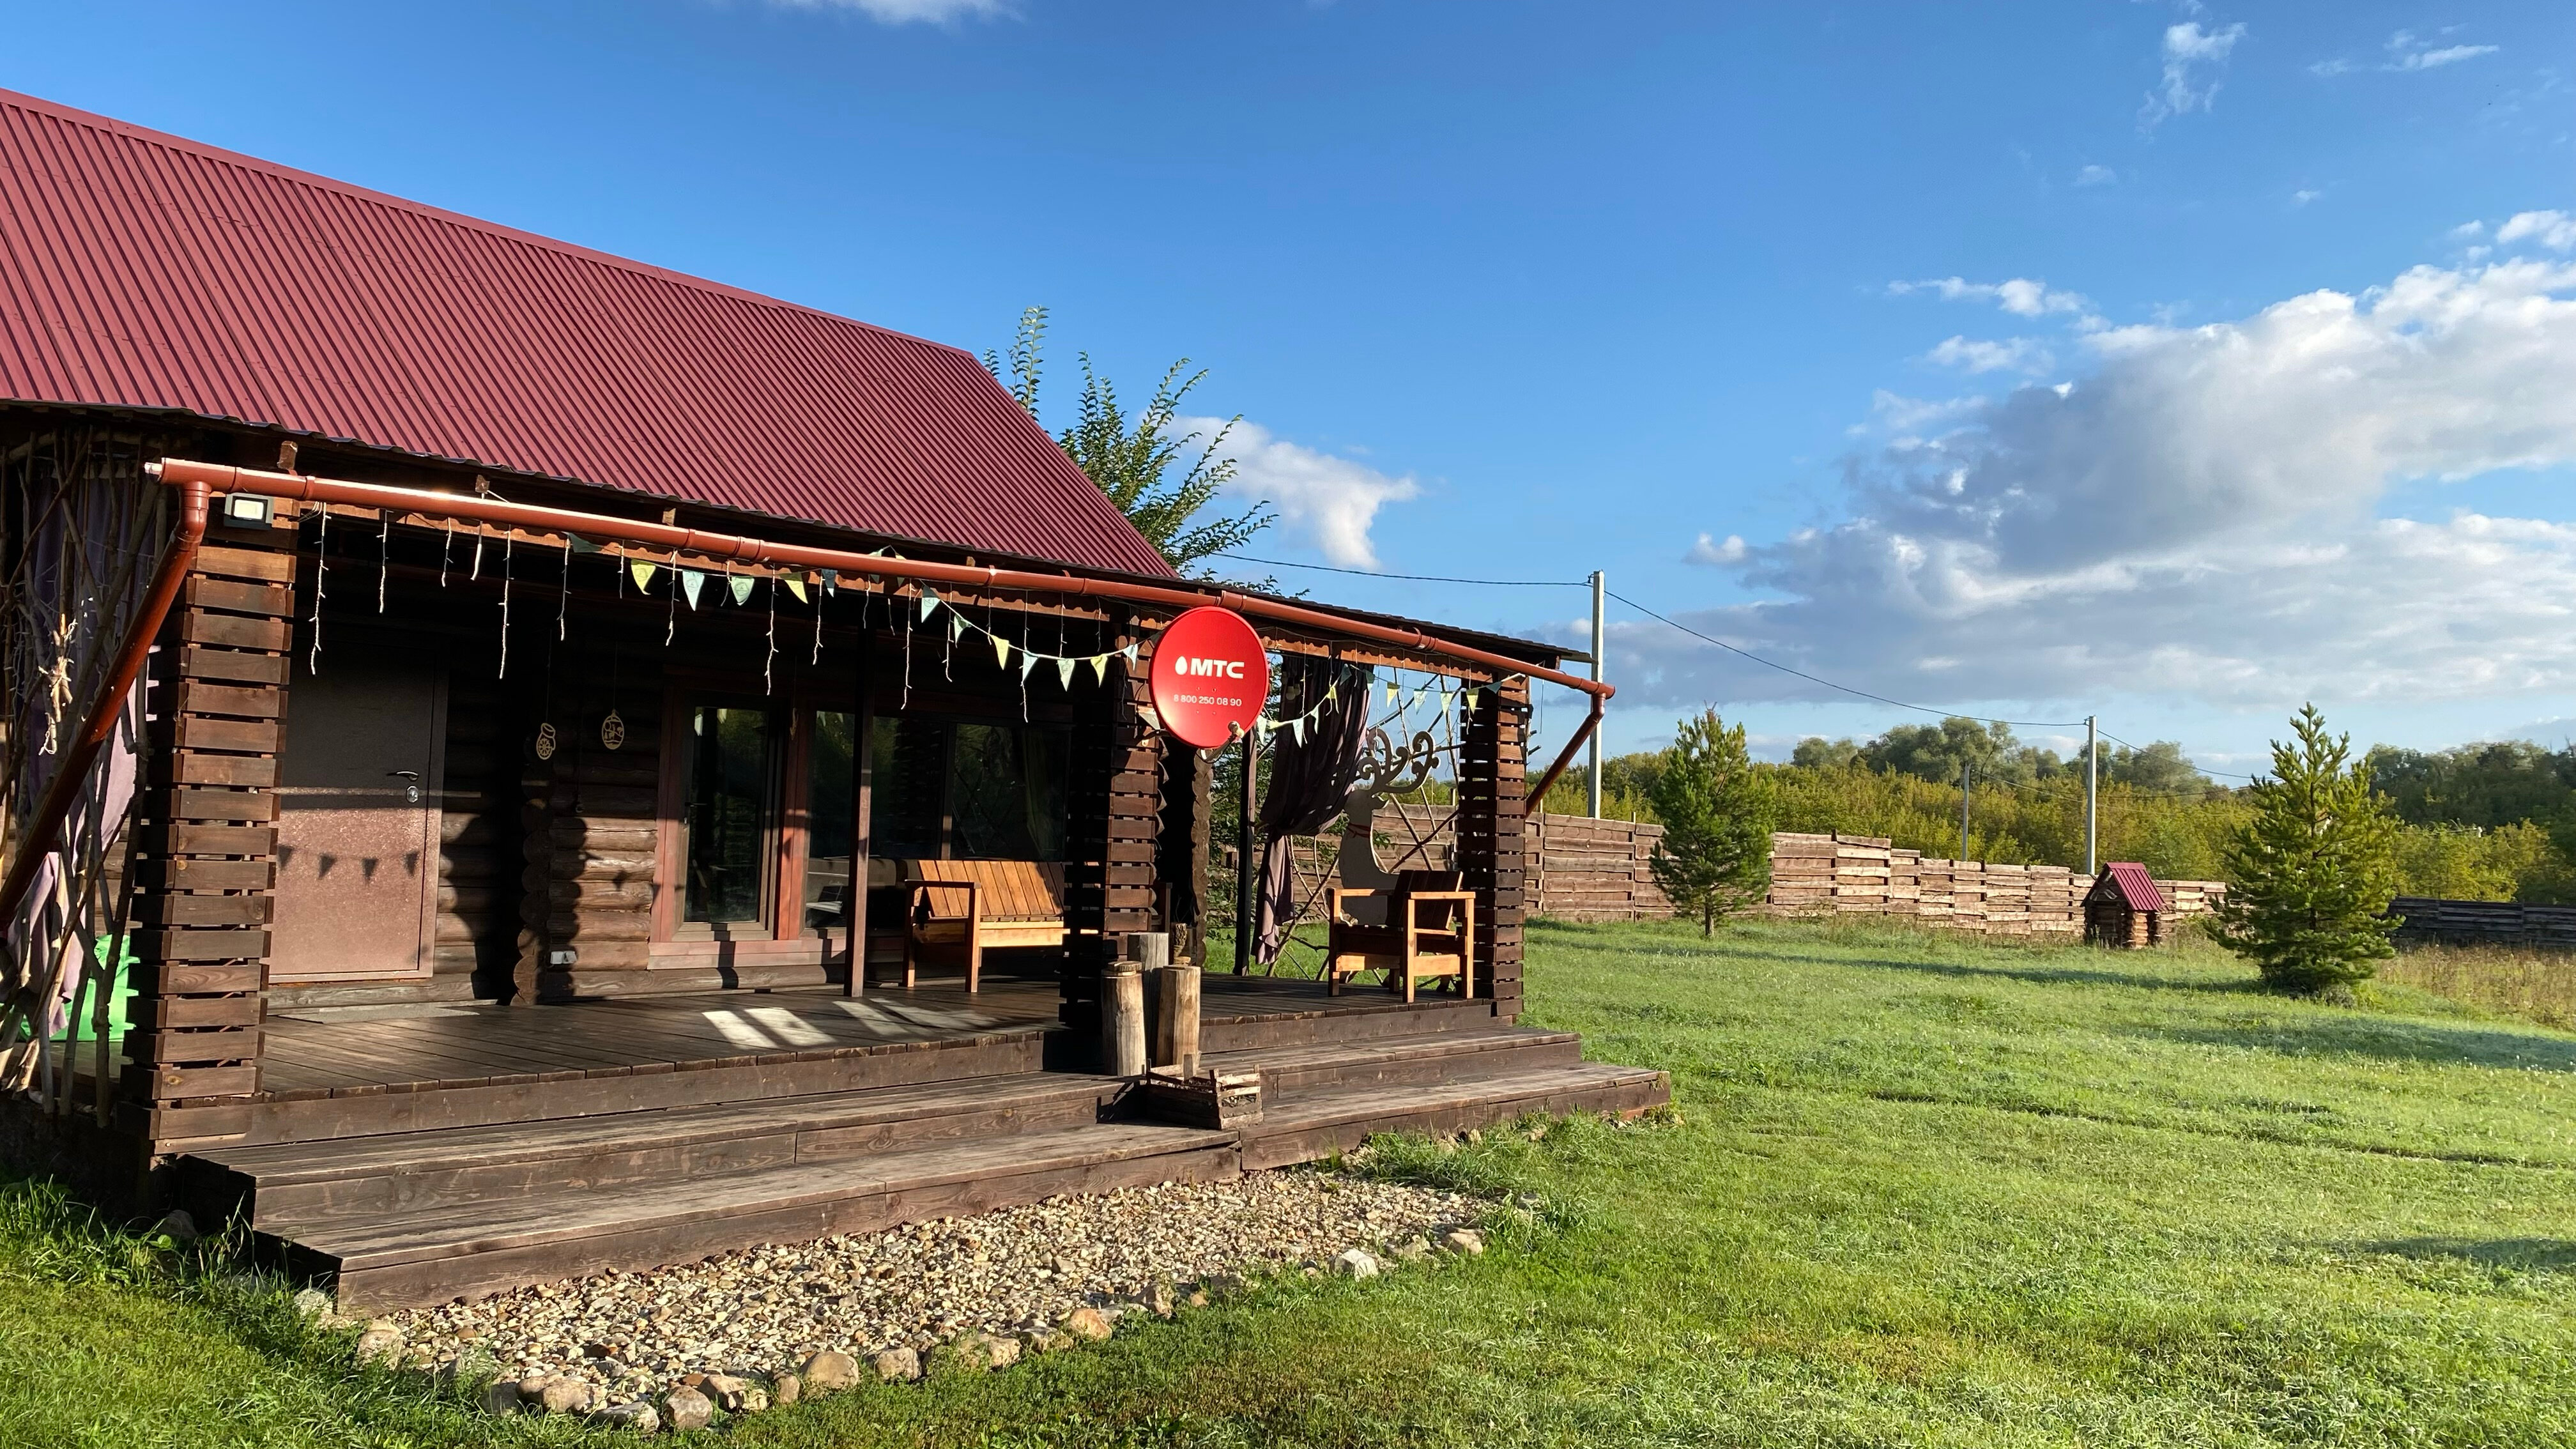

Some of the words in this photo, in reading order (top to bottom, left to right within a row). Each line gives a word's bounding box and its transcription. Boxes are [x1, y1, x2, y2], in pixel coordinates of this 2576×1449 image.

[1190, 657, 1245, 679] МТС
[1173, 694, 1179, 702] 8
[1180, 694, 1197, 704] 800
[1199, 696, 1215, 705] 250
[1216, 697, 1229, 706] 08
[1230, 698, 1243, 707] 90
